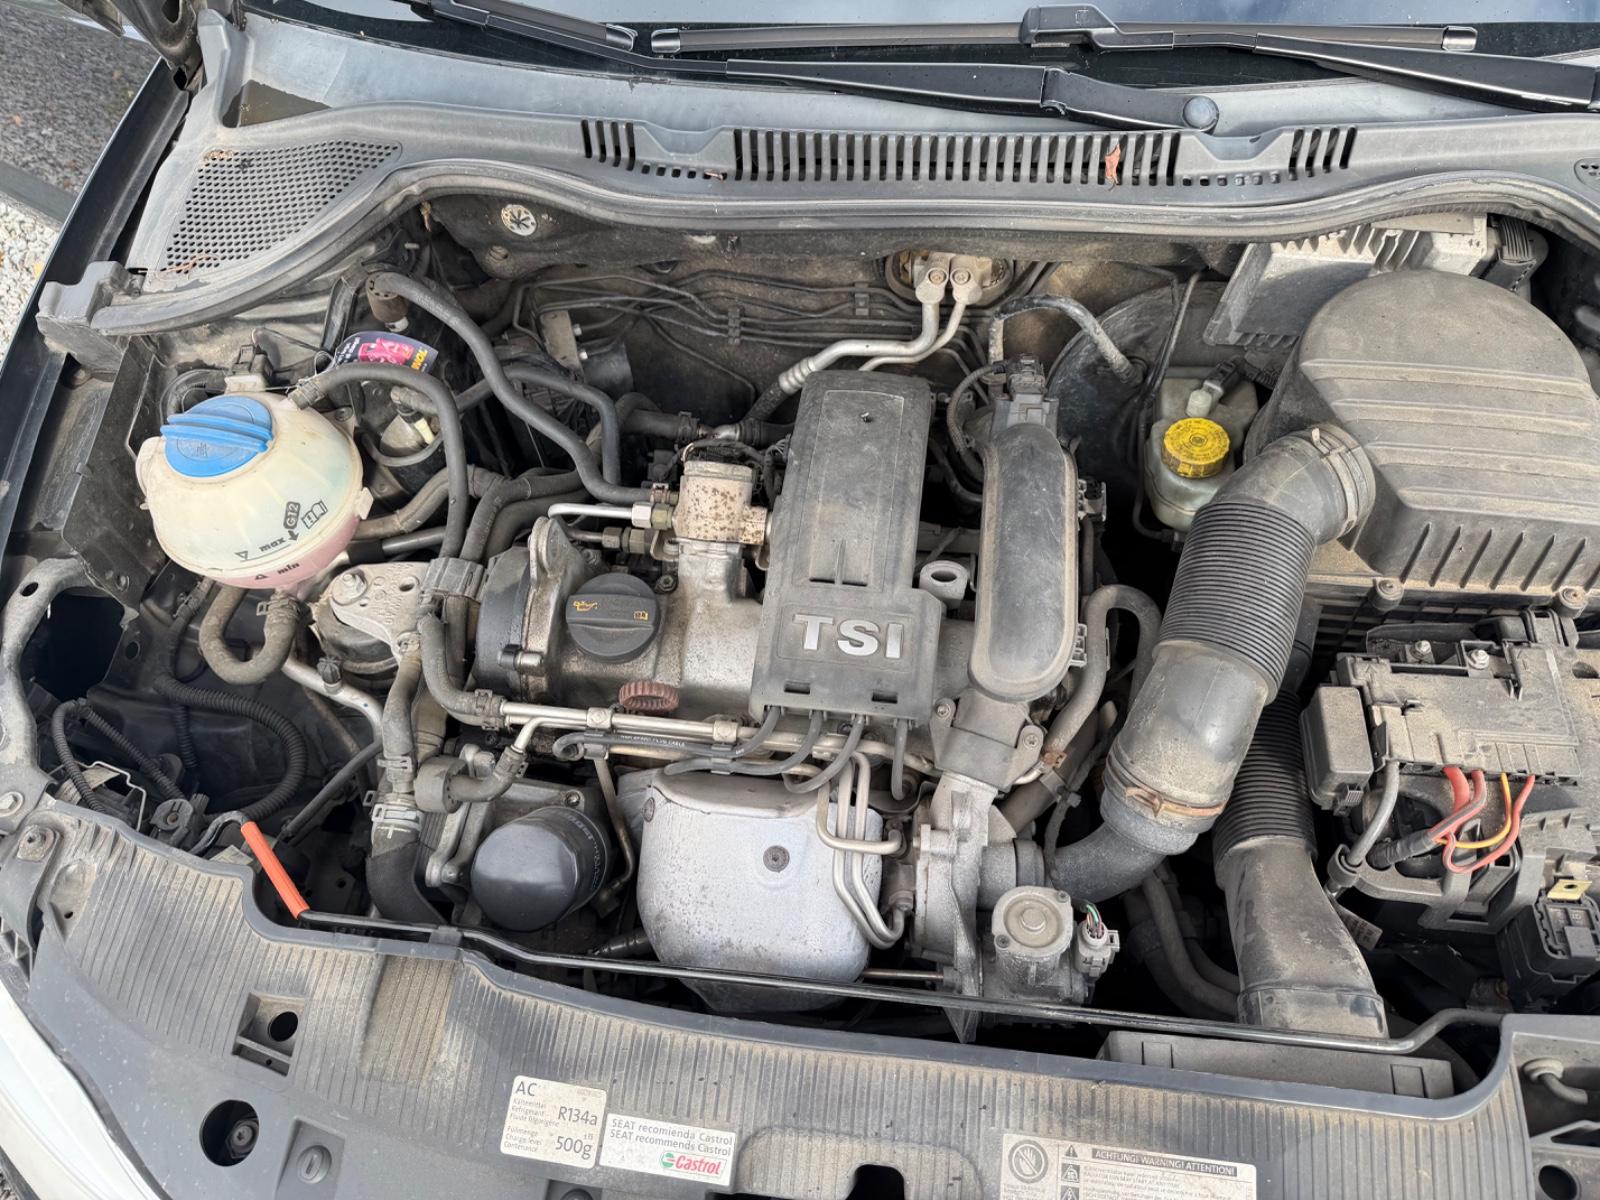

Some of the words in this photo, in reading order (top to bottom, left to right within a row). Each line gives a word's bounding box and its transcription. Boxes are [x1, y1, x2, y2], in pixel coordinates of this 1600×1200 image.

[287, 504, 299, 526] G12
[259, 537, 286, 551] max
[277, 563, 299, 574] min
[793, 614, 904, 659] TSI
[515, 1081, 538, 1097] AC
[557, 1105, 598, 1126] R134a
[610, 1128, 633, 1140] SEAT
[635, 1134, 696, 1151] recommends
[697, 1143, 732, 1156] Castrol
[612, 1118, 636, 1131] SEAT
[638, 1122, 696, 1141] recomienda
[699, 1132, 734, 1146] Castrol
[555, 1135, 593, 1160] 500g
[675, 1155, 724, 1175] Castrol
[1095, 1151, 1138, 1165] ACHTUNG!
[1140, 1157, 1184, 1170] WARNING!
[1184, 1163, 1236, 1177] ATTENTION!
